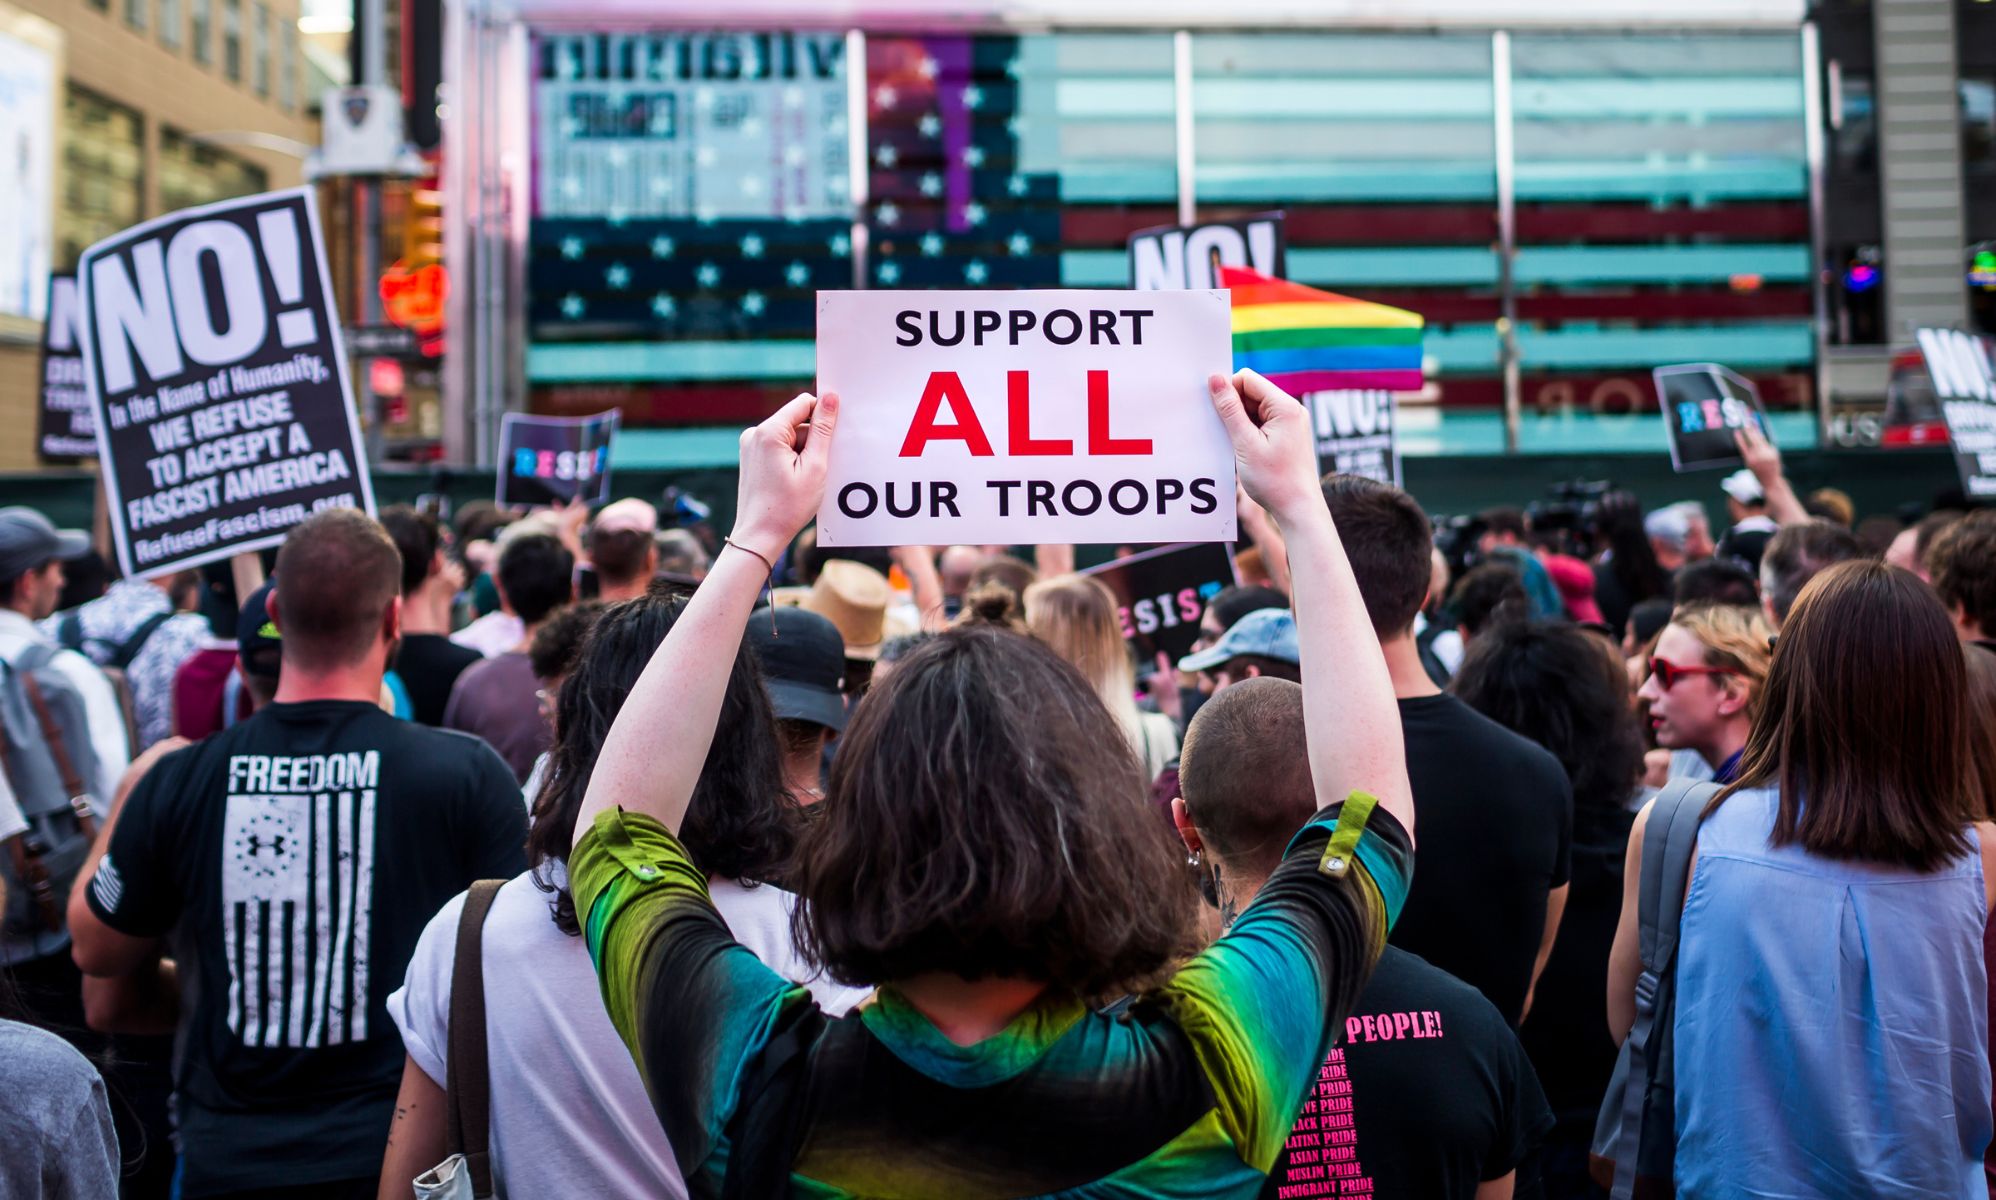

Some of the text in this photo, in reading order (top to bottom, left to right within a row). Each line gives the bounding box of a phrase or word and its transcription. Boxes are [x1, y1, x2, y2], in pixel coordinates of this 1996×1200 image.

[92, 206, 318, 394] NO!
[896, 309, 1153, 346] SUPPORT
[127, 394, 157, 424] the
[157, 381, 206, 413] Name
[207, 369, 229, 397] of
[230, 354, 330, 394] Humanity,
[150, 415, 192, 452] WE
[191, 391, 293, 441] REFUSE
[898, 370, 1153, 457] ALL
[147, 421, 312, 488] TO ACCEPT A
[128, 449, 350, 530] FASCIST AMERICA
[837, 479, 1218, 519] OUR TROOPS
[229, 751, 379, 792] FREEDOM
[1345, 1011, 1443, 1044] PEOPLE!
[1319, 1064, 1347, 1079] RIDE
[1320, 1080, 1353, 1096] PRIDE
[1320, 1097, 1354, 1113] PRIDE
[1321, 1113, 1354, 1129] PRIDE
[1324, 1129, 1357, 1145] PRIDE
[1287, 1162, 1362, 1182] MUSLIM PRIDE
[1290, 1146, 1356, 1165] ASIAN PRIDE
[1278, 1177, 1374, 1200] IMMIGRANT PRIDE
